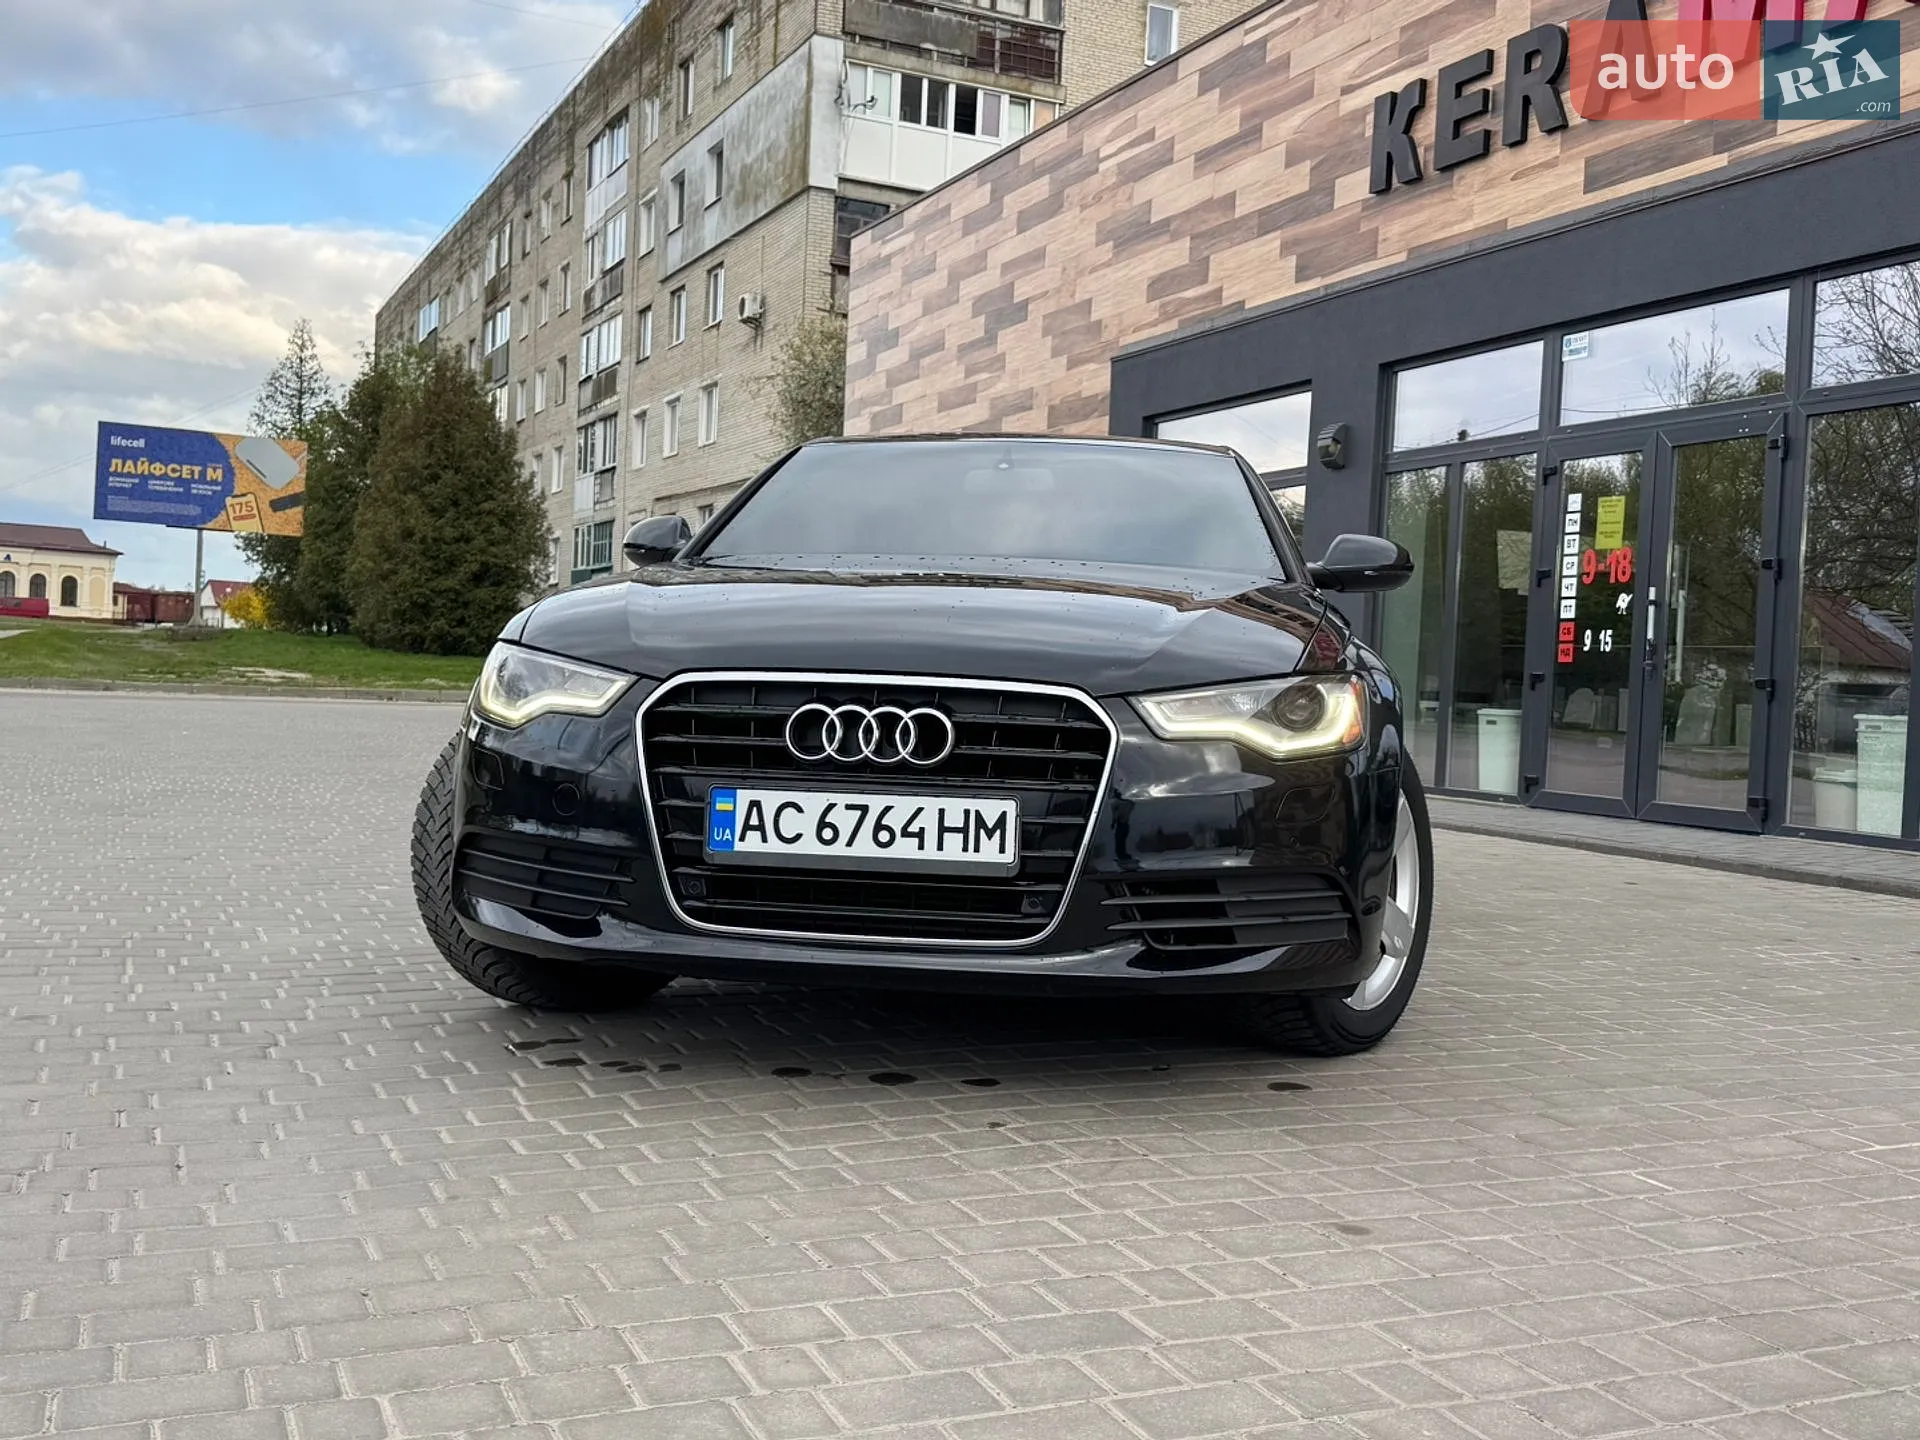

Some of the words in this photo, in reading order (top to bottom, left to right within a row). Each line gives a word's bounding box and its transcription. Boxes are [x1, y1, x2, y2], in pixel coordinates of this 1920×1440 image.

[110, 436, 145, 448] lifecell
[109, 457, 202, 480] ЛАЙФСЕТ
[206, 467, 223, 482] М
[230, 501, 254, 514] 175
[1568, 518, 1578, 527] ПН
[1566, 538, 1577, 548] ВТ
[1565, 561, 1575, 570] СР
[1582, 546, 1633, 585] 9-18
[1564, 583, 1575, 592] ЧТ
[1562, 604, 1573, 614] ПТ
[1561, 626, 1572, 636] СБ
[1583, 629, 1592, 651] 9
[1599, 629, 1613, 652] 15
[816, 802, 925, 850] 6764
[714, 827, 732, 842] UA
